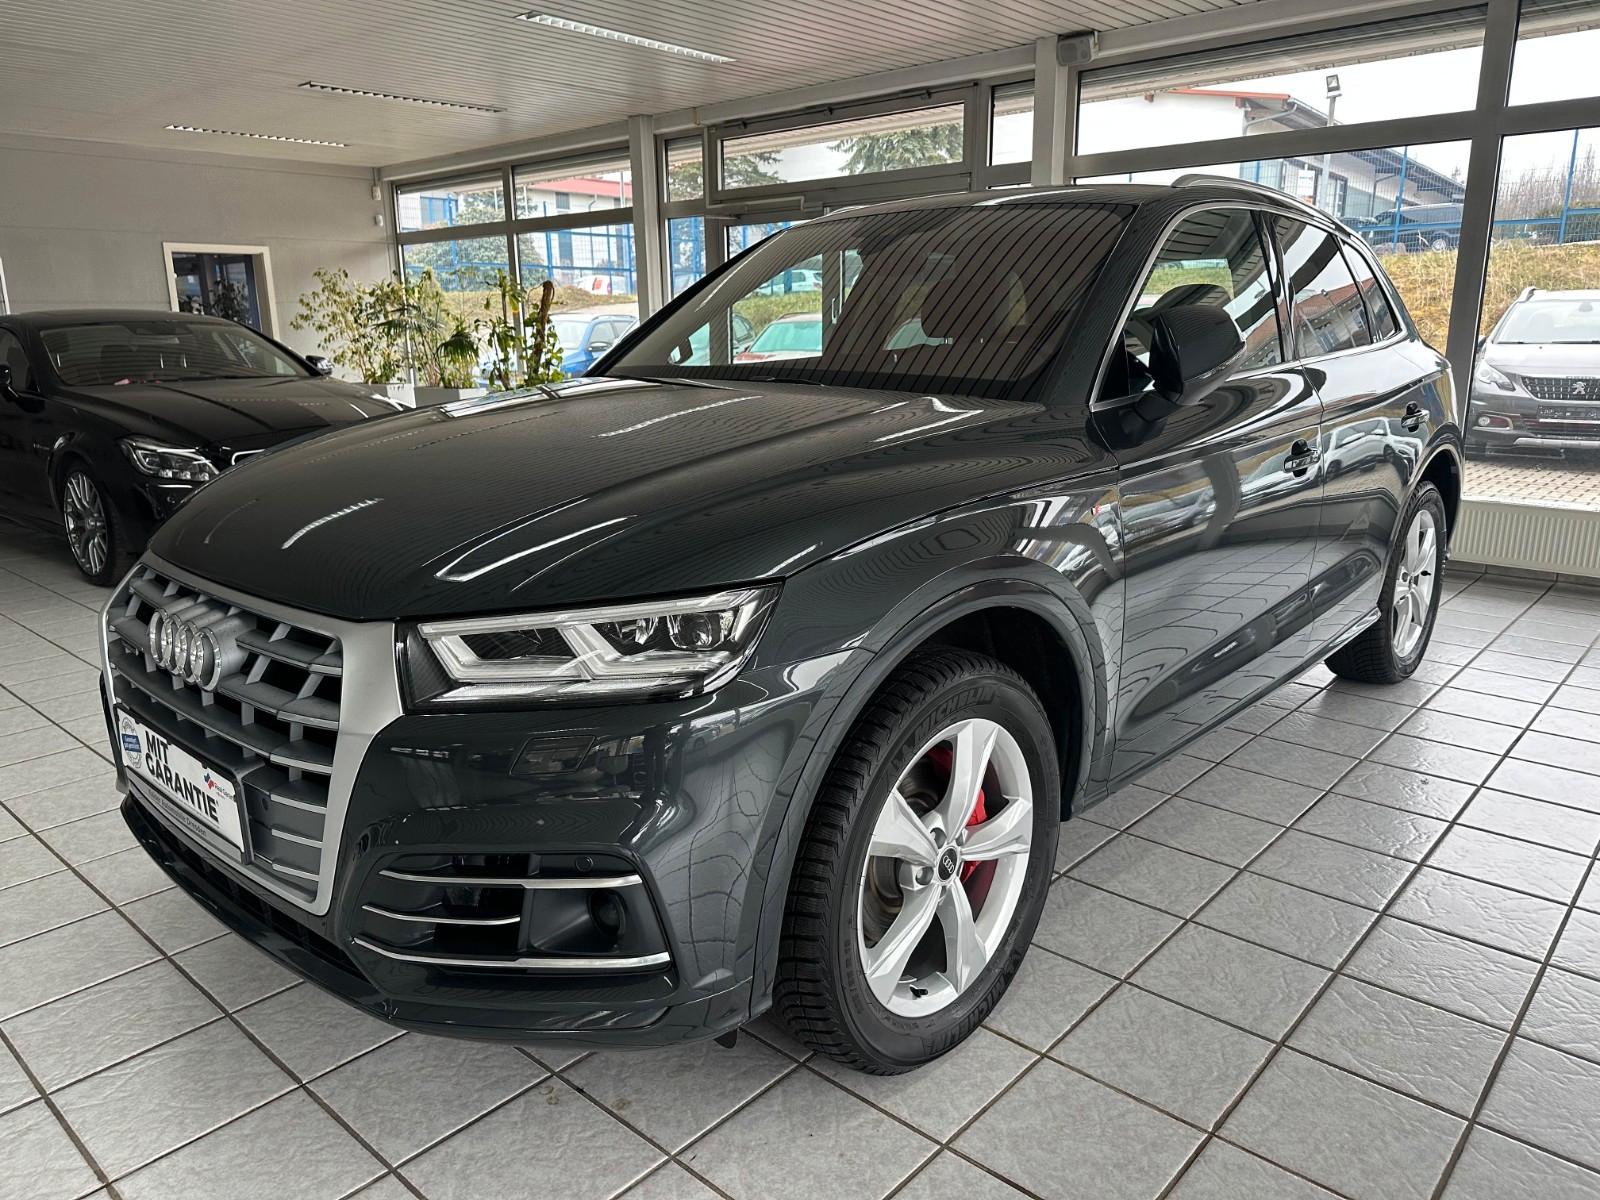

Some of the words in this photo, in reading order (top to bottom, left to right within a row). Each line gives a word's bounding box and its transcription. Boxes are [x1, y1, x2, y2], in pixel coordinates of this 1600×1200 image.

[914, 686, 997, 743] MICHELIN
[145, 730, 169, 765] MIT
[145, 752, 219, 823] GARANTIE
